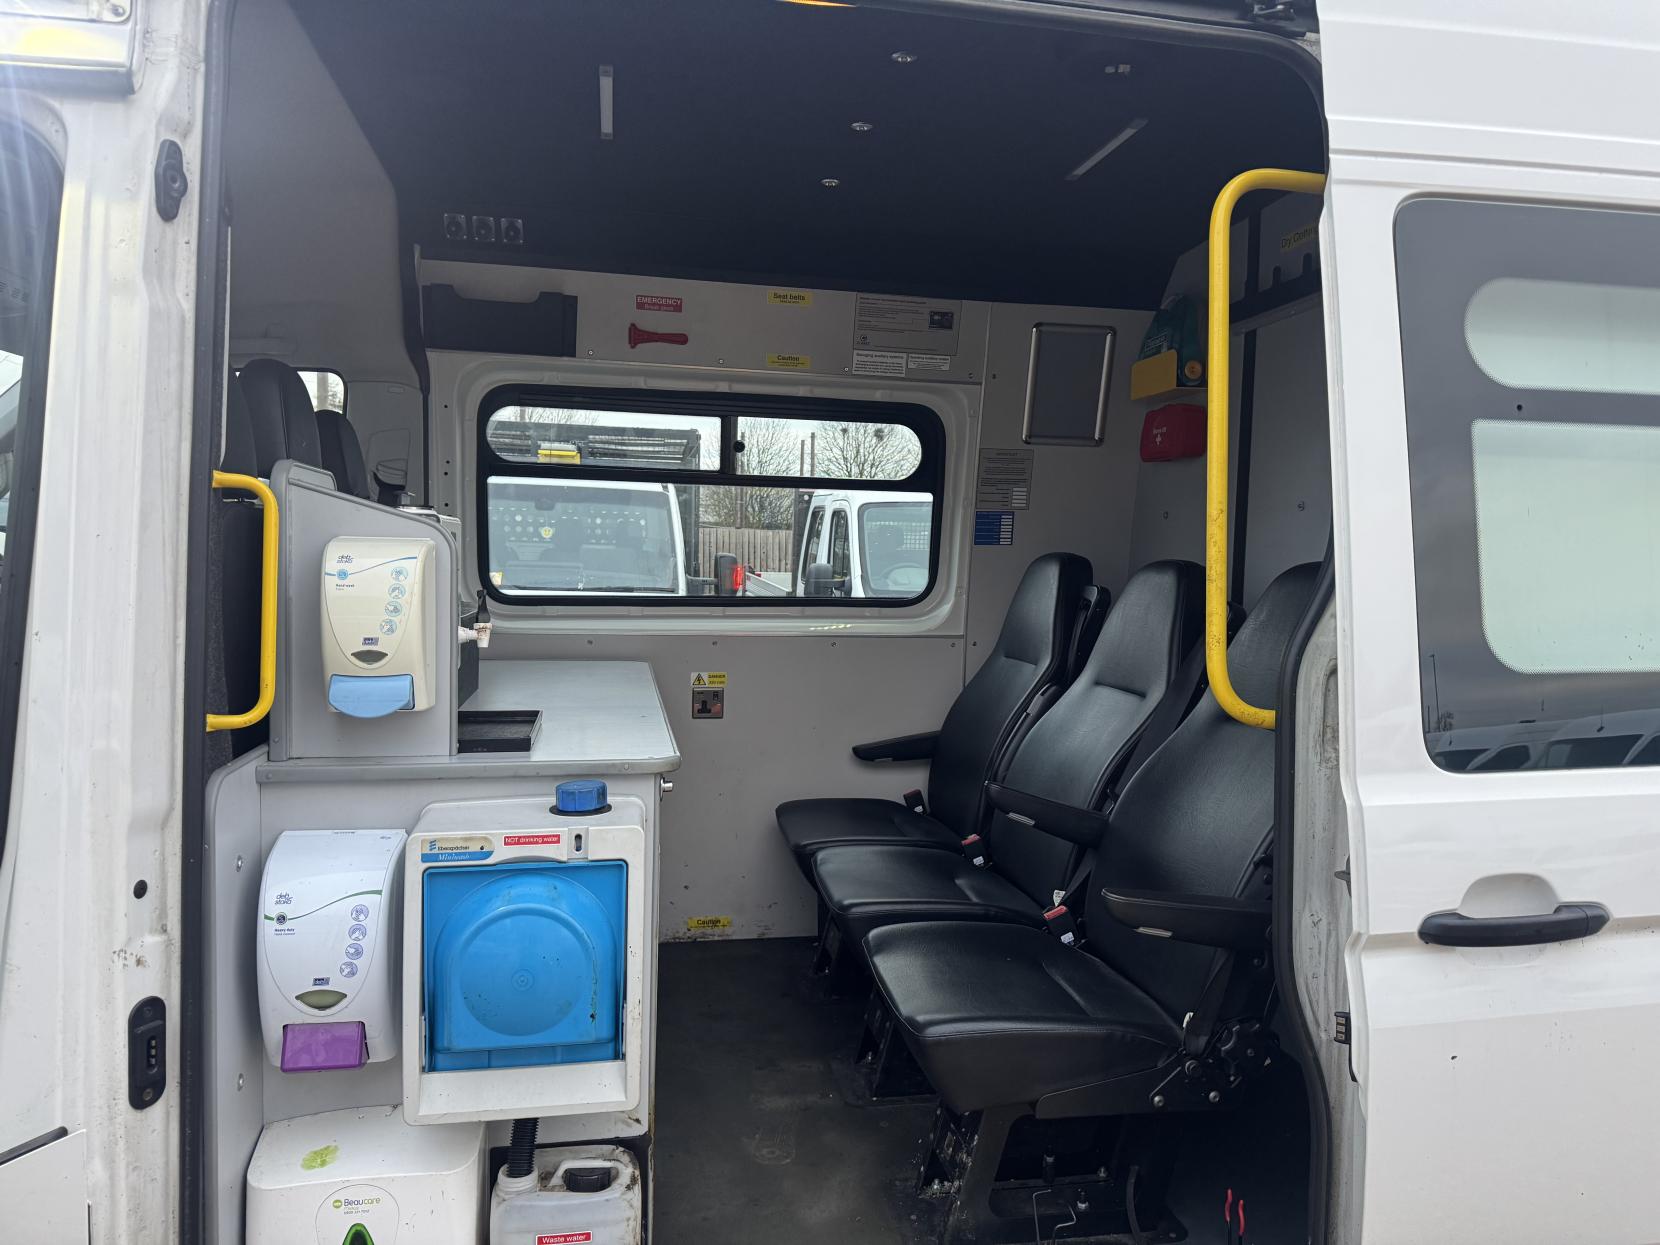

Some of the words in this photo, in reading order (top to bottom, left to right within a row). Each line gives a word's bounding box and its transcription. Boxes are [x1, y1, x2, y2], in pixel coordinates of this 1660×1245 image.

[637, 296, 681, 305] EMERGENCY
[789, 293, 806, 301] belts
[777, 354, 800, 362] Caution
[519, 836, 543, 844] drinking
[696, 919, 721, 927] Caution
[343, 1197, 381, 1207] Beaucare
[542, 1236, 565, 1244] Waste
[566, 1234, 587, 1242] water
